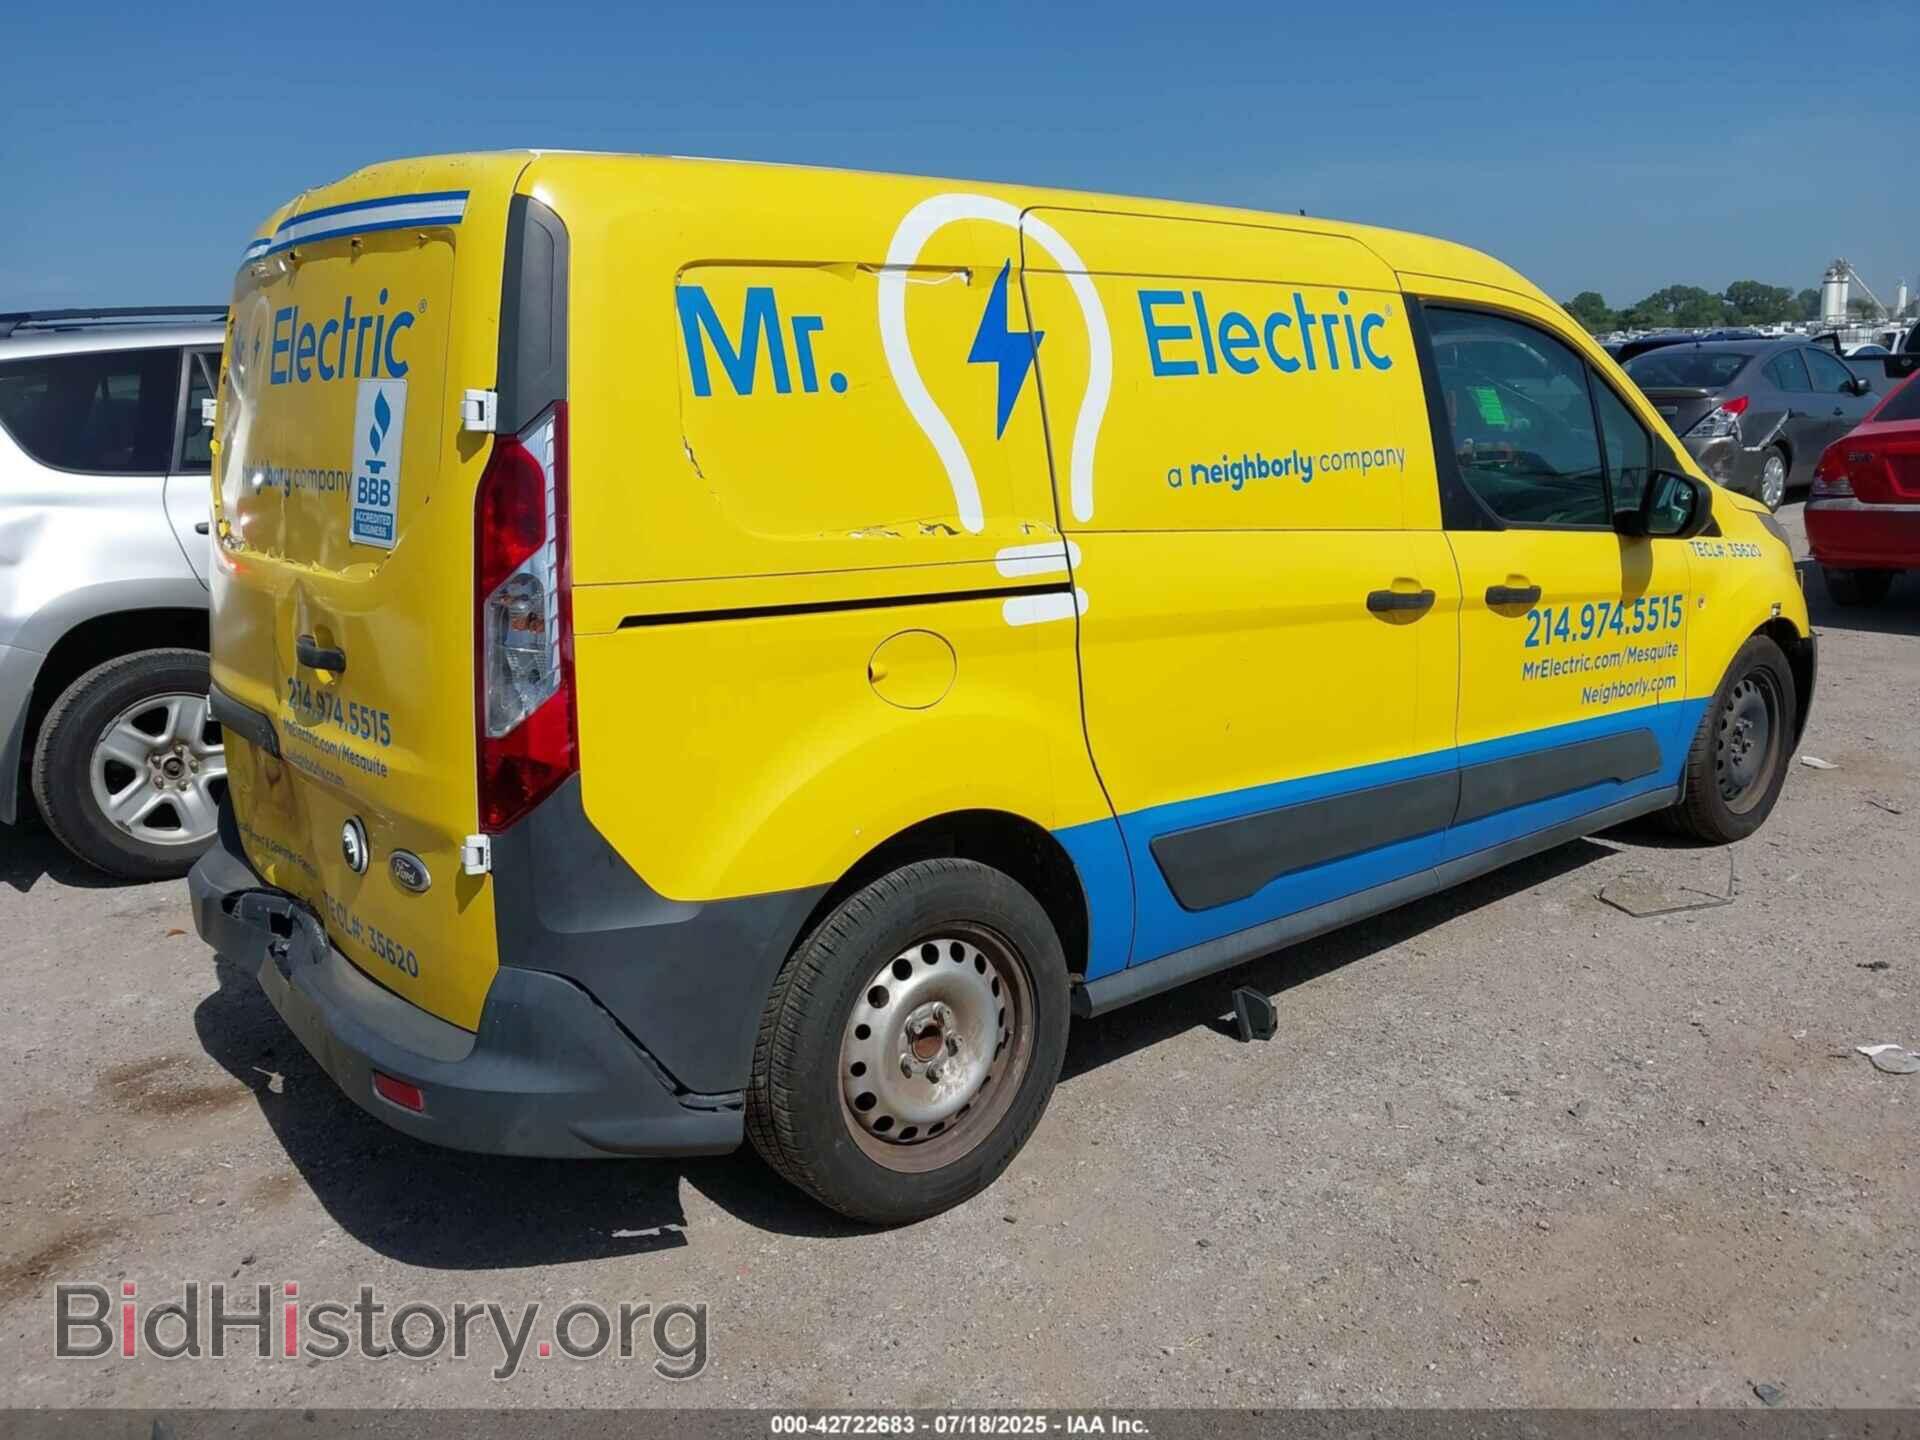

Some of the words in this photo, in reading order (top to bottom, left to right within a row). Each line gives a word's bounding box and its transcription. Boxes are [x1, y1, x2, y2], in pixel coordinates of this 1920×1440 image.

[676, 286, 848, 396] Mr.
[294, 467, 352, 502] company
[1167, 469, 1182, 488] a
[1191, 451, 1313, 491] neighborly
[1319, 447, 1405, 476] company
[358, 476, 391, 507] BBB
[1728, 543, 1761, 557] 35620
[1524, 594, 1683, 648] 214.974.5515
[1521, 642, 1679, 680] MrElectric.com/Mesquite
[1581, 675, 1676, 705] Neighborly.com
[288, 677, 391, 748] 214.974.5515
[395, 859, 417, 886] Ford
[368, 925, 418, 978] 35620
